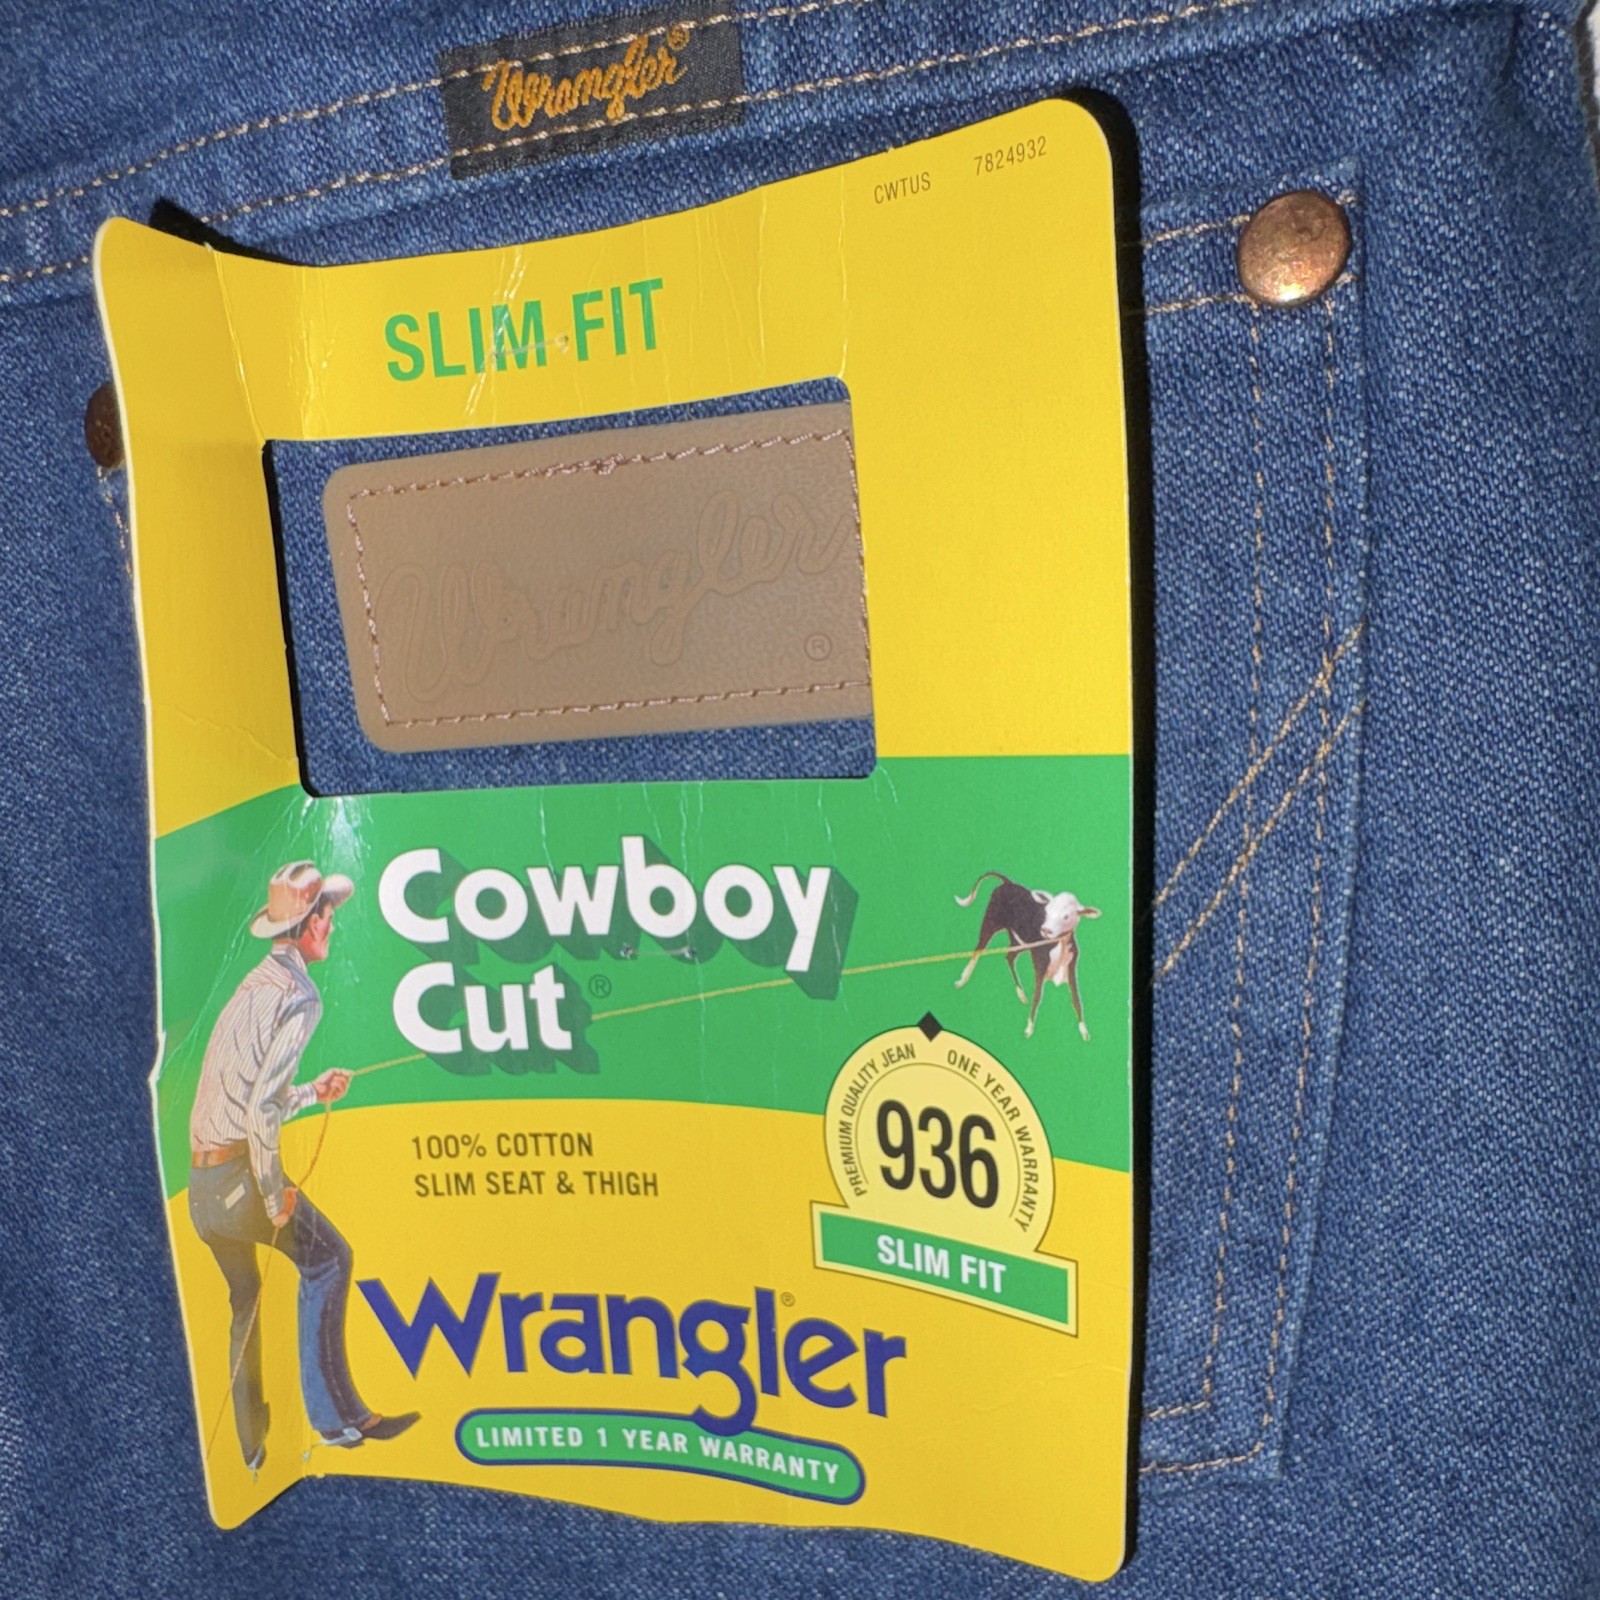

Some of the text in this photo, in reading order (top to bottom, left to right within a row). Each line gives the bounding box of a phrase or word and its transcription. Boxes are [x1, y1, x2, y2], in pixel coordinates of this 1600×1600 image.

[481, 36, 688, 131] Wrangler
[873, 135, 1048, 206] CWTUS 7824932
[384, 277, 664, 381] SLIM FIT
[378, 835, 832, 972] Cowboy
[392, 961, 573, 1054] Cut
[411, 1132, 594, 1161] 100% COTTON
[838, 1042, 917, 1197] PREMIUM QUALITY JEAN
[876, 1099, 999, 1209] 936
[947, 1049, 1039, 1233] ONE YEAR WARRANTY
[414, 1171, 660, 1199] SLIM SEAT & THIGH
[876, 1233, 1007, 1294] SLIM FIT
[356, 1272, 907, 1436] Wrangler
[475, 1426, 839, 1484] LIMITED 1 YEAR WARRANTY
